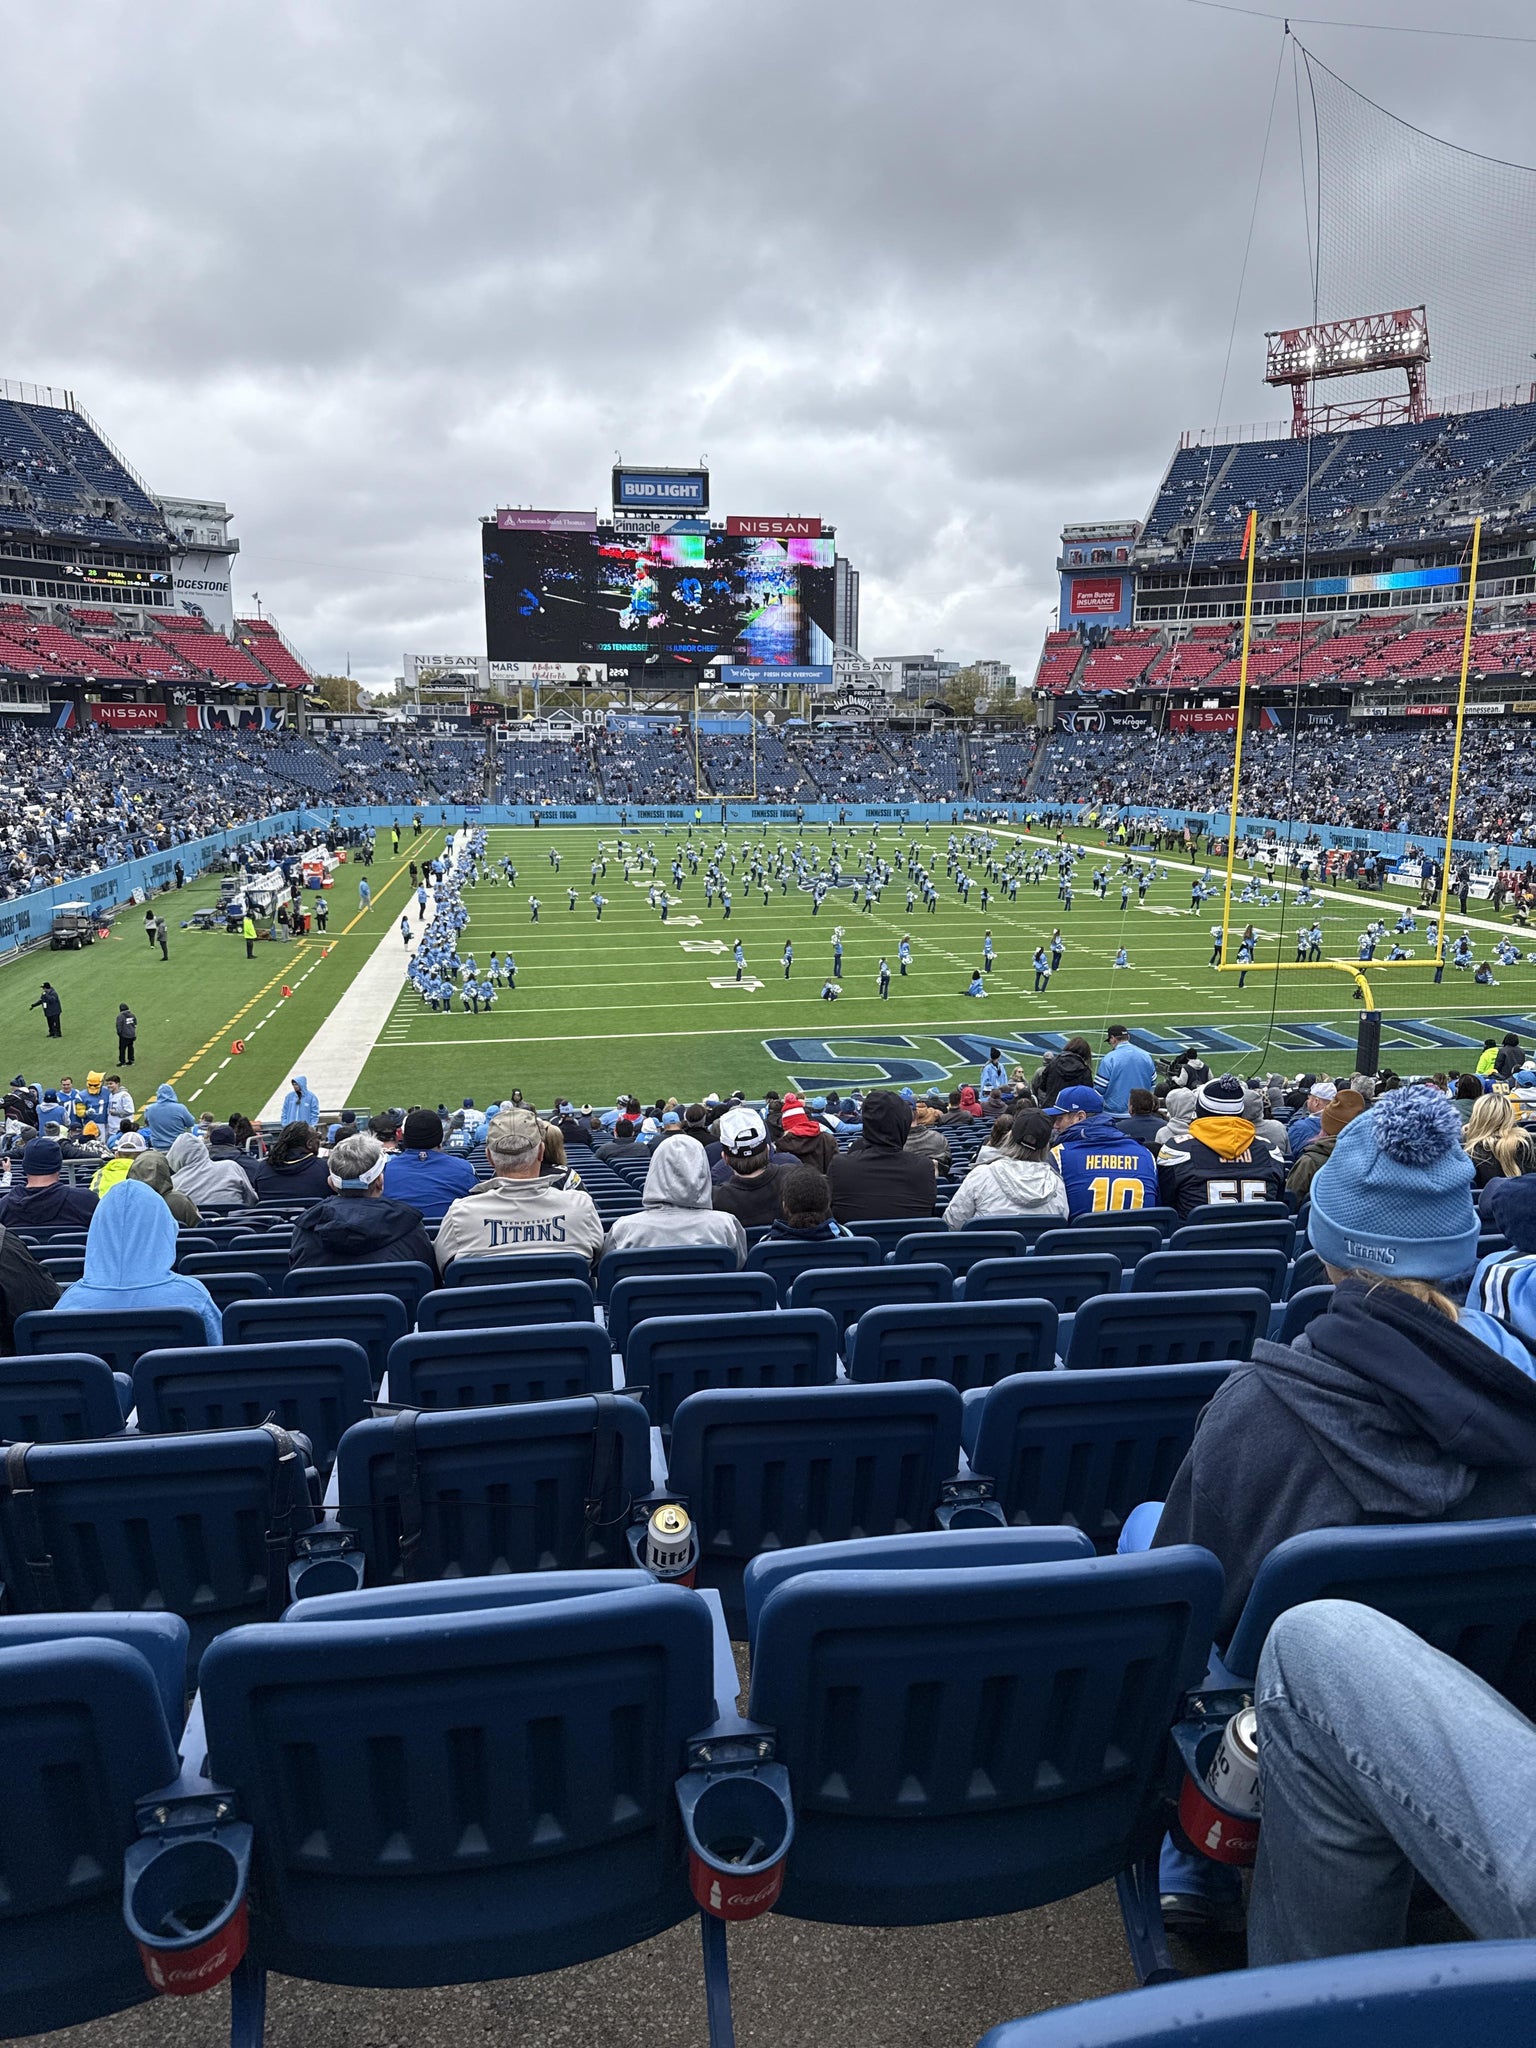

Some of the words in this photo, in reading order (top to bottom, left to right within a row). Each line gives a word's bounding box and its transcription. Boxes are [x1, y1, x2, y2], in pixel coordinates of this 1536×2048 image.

[624, 483, 654, 496] BUD
[657, 484, 699, 497] LIGHT
[563, 518, 586, 526] Thomas
[615, 520, 661, 532] Pinnacle
[739, 521, 809, 533] NISSAN
[1076, 598, 1115, 606] INSURANCE
[612, 643, 650, 652] TENNESSEE
[415, 656, 477, 665] NISSAN
[491, 663, 520, 671] MARS
[836, 663, 892, 671] NISSAN
[740, 668, 761, 680] Kroger
[833, 697, 849, 710] JACK
[101, 708, 158, 718] NISSAN
[1179, 713, 1235, 722] NISSAN
[1121, 715, 1148, 729] Kroger
[1307, 713, 1334, 725] TITANS
[559, 810, 577, 819] TOUGH
[637, 810, 666, 818] TENNESSEE
[666, 810, 684, 818] TOUGH
[751, 809, 779, 817] TENNESSEE
[865, 808, 892, 817] TENNESSEE
[1085, 1154, 1139, 1170] HERBERT
[1087, 1177, 1145, 1213] 10
[505, 1218, 550, 1226] TENNESSEE
[484, 1215, 565, 1248] TITANS
[1343, 1236, 1397, 1265] TITANS
[727, 1876, 779, 1906] Coca-Cola
[168, 1947, 228, 1982] Coca-Cola
